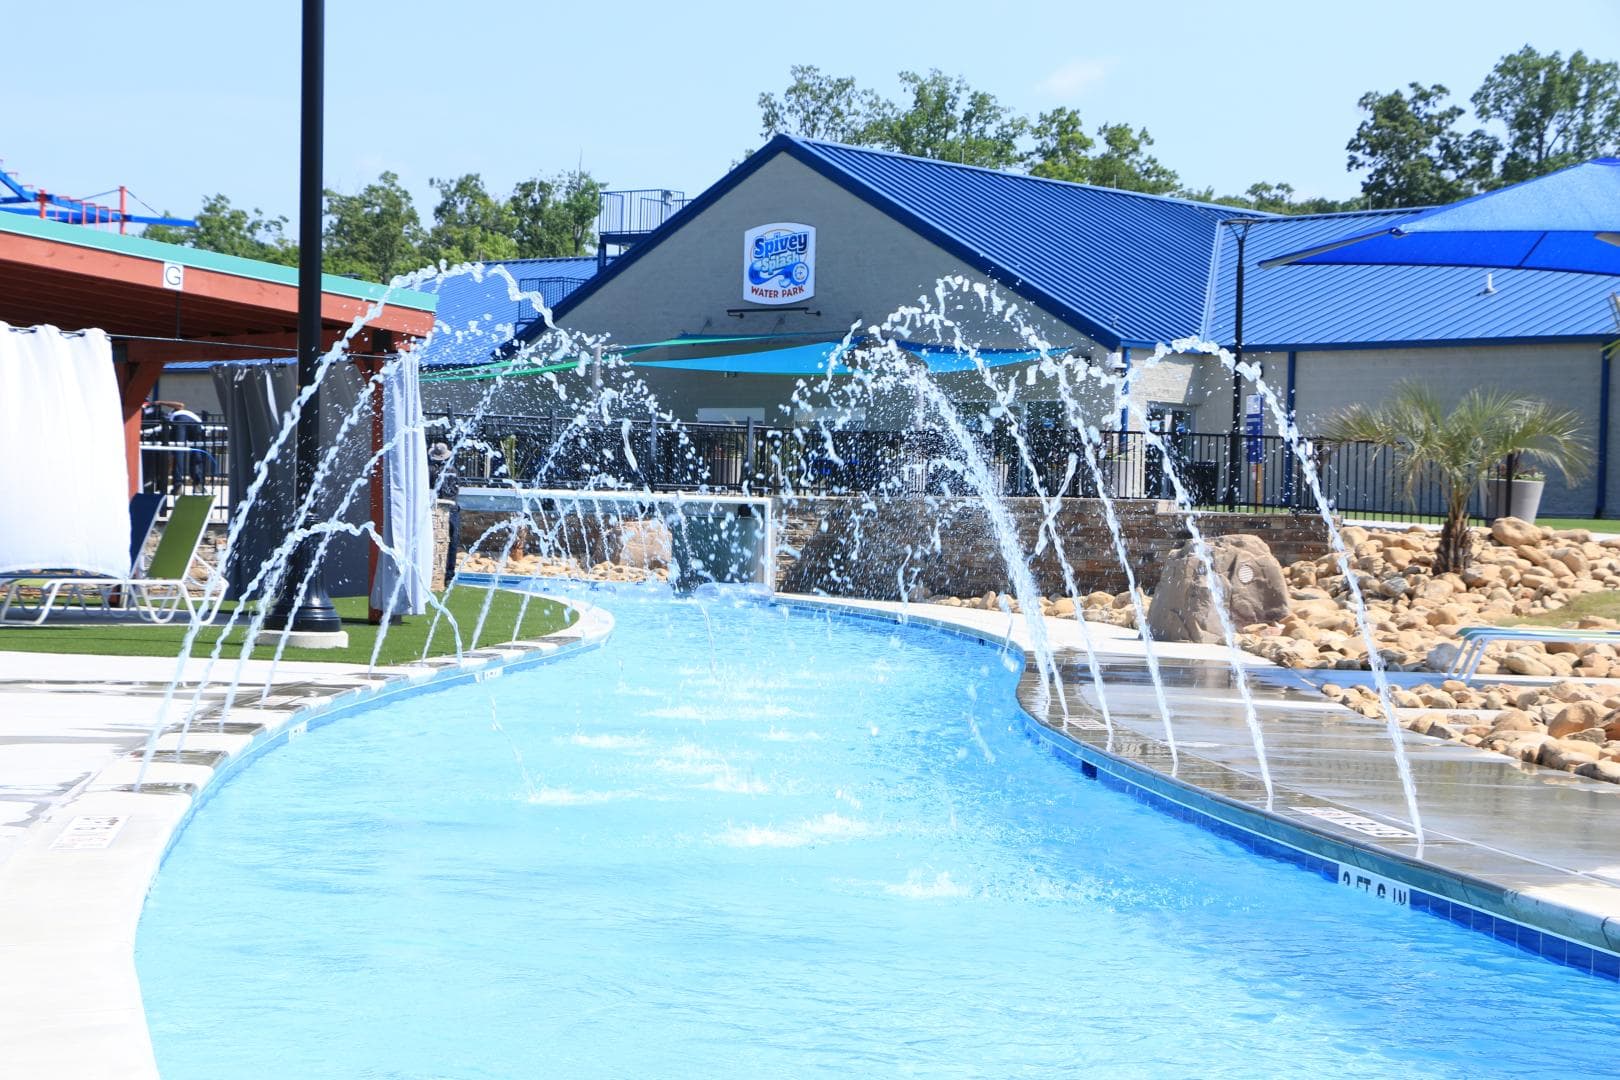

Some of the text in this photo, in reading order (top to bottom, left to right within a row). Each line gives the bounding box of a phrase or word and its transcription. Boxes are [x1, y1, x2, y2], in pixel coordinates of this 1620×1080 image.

[754, 232, 809, 258] Spivey
[166, 266, 181, 285] G
[751, 285, 804, 298] WATER PARK
